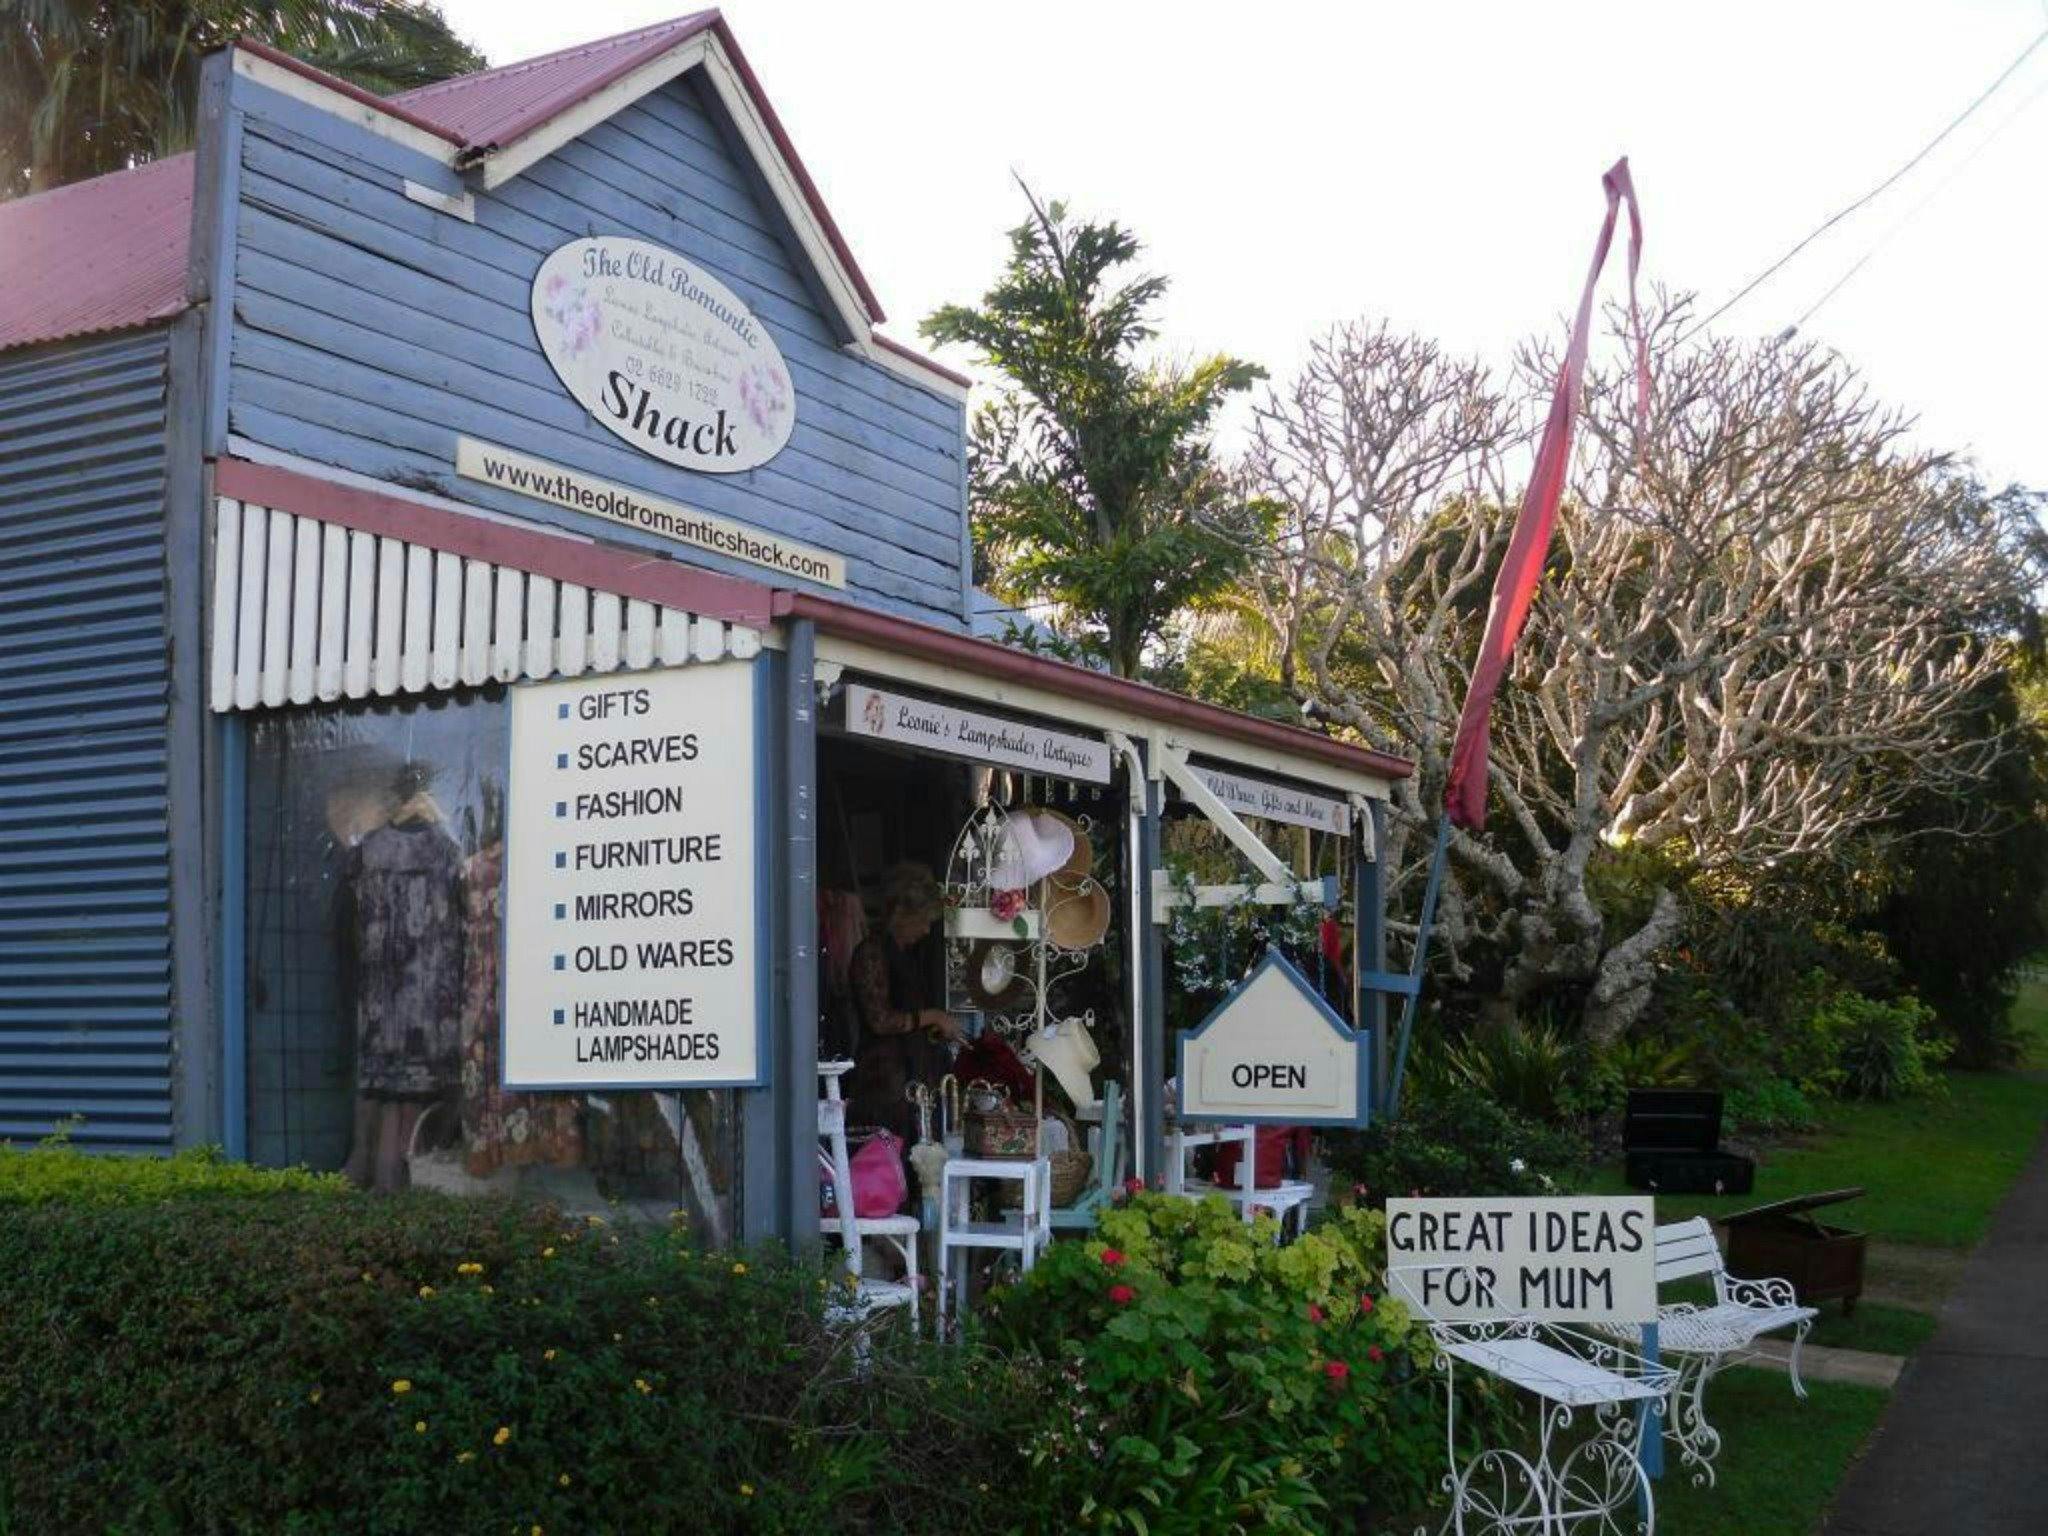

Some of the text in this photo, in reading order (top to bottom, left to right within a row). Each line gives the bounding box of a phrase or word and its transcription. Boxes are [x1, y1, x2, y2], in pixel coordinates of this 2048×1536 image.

[583, 247, 621, 278] The
[627, 250, 664, 287] Old
[669, 267, 760, 349] Romantic
[601, 370, 739, 456] Shack
[483, 455, 831, 581] www.theoldromanticshack.com
[578, 689, 650, 720] GIFTS
[577, 734, 699, 770] SCARVES
[897, 706, 949, 737] Leonie's
[1042, 738, 1094, 769] Antiques
[576, 786, 682, 820] FASHION
[575, 834, 721, 870] FURNITURE
[575, 888, 693, 920] MIRRORS
[575, 938, 733, 972] OLD WARES
[575, 998, 693, 1028] HANDMADE
[576, 1033, 719, 1062] LAMPSHADES
[1232, 1064, 1306, 1088] OPEN
[1390, 1210, 1644, 1252] GREAT IDEAS
[1423, 1266, 1613, 1309] FOR MUM
